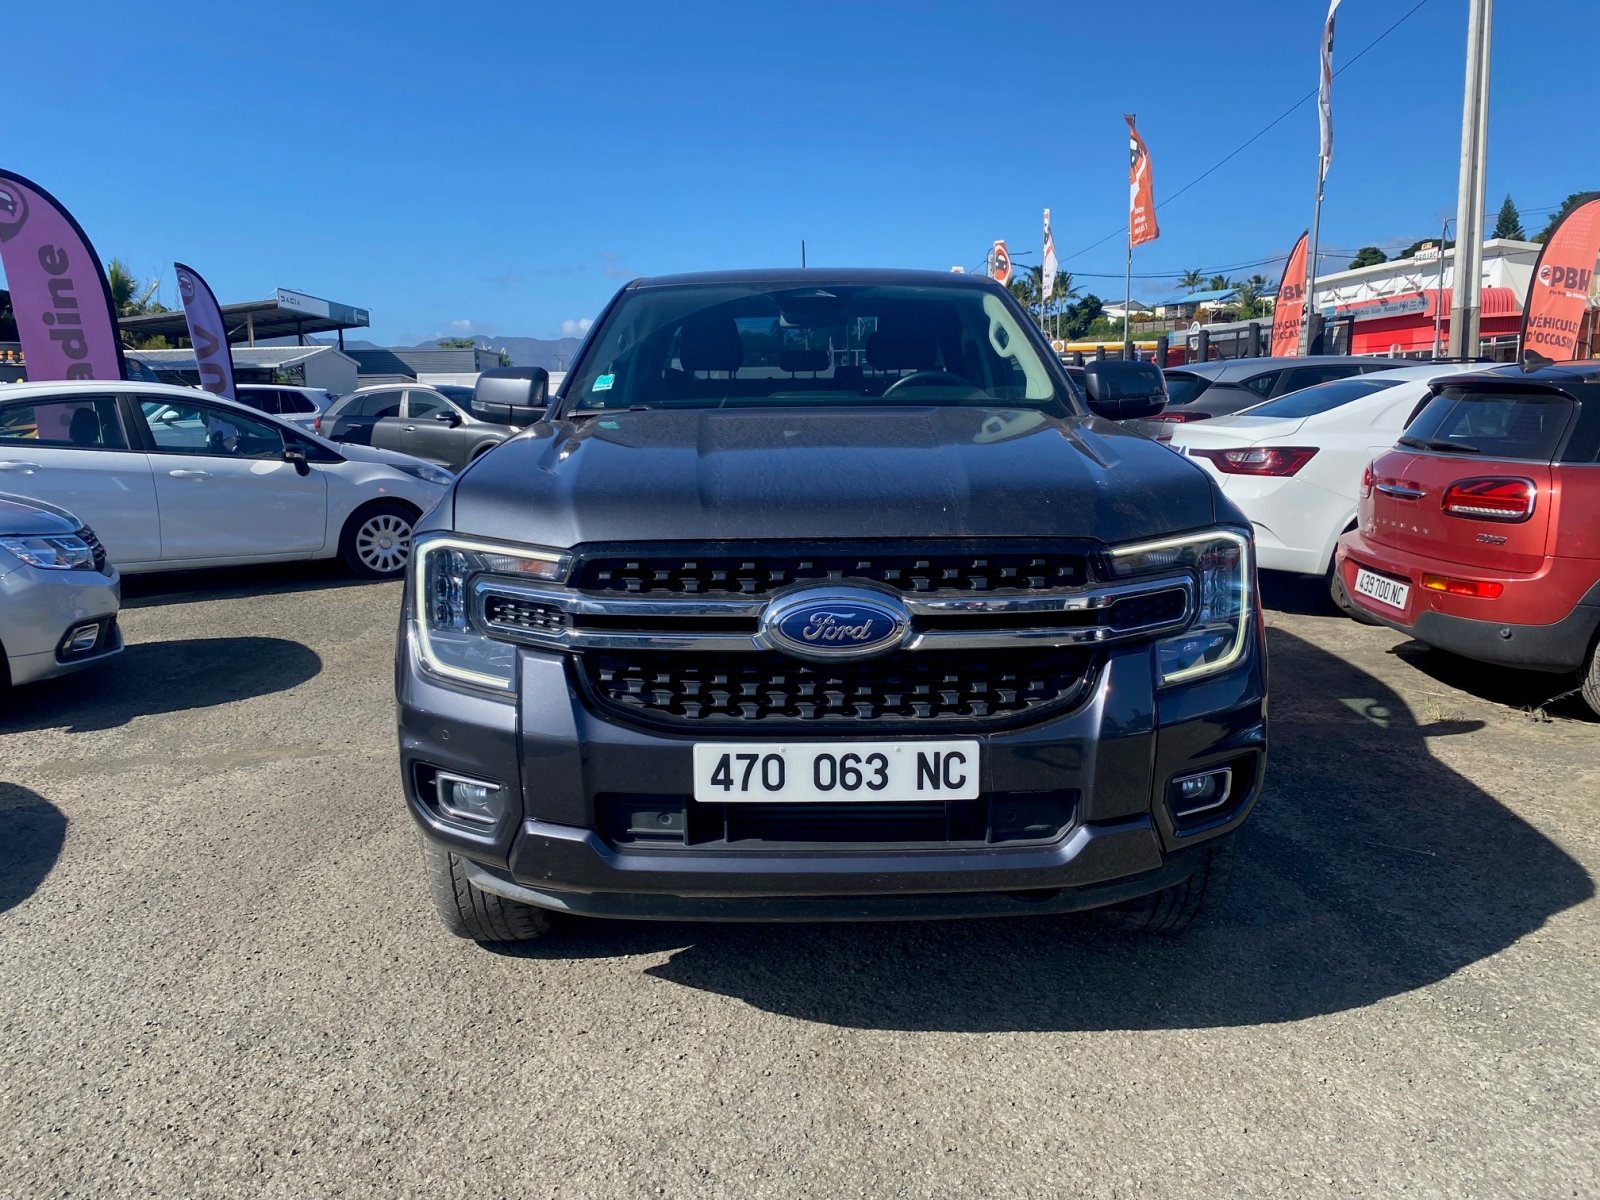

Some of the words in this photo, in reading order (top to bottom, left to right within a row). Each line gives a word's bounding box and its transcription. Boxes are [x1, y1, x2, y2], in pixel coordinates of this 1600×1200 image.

[1551, 266, 1591, 291] PBH
[1360, 573, 1375, 594] 439
[1375, 578, 1391, 600] 700
[1390, 584, 1404, 605] NC
[802, 611, 874, 641] Ford
[710, 753, 785, 791] 470
[813, 753, 889, 791] 063
[916, 751, 967, 790] NC
